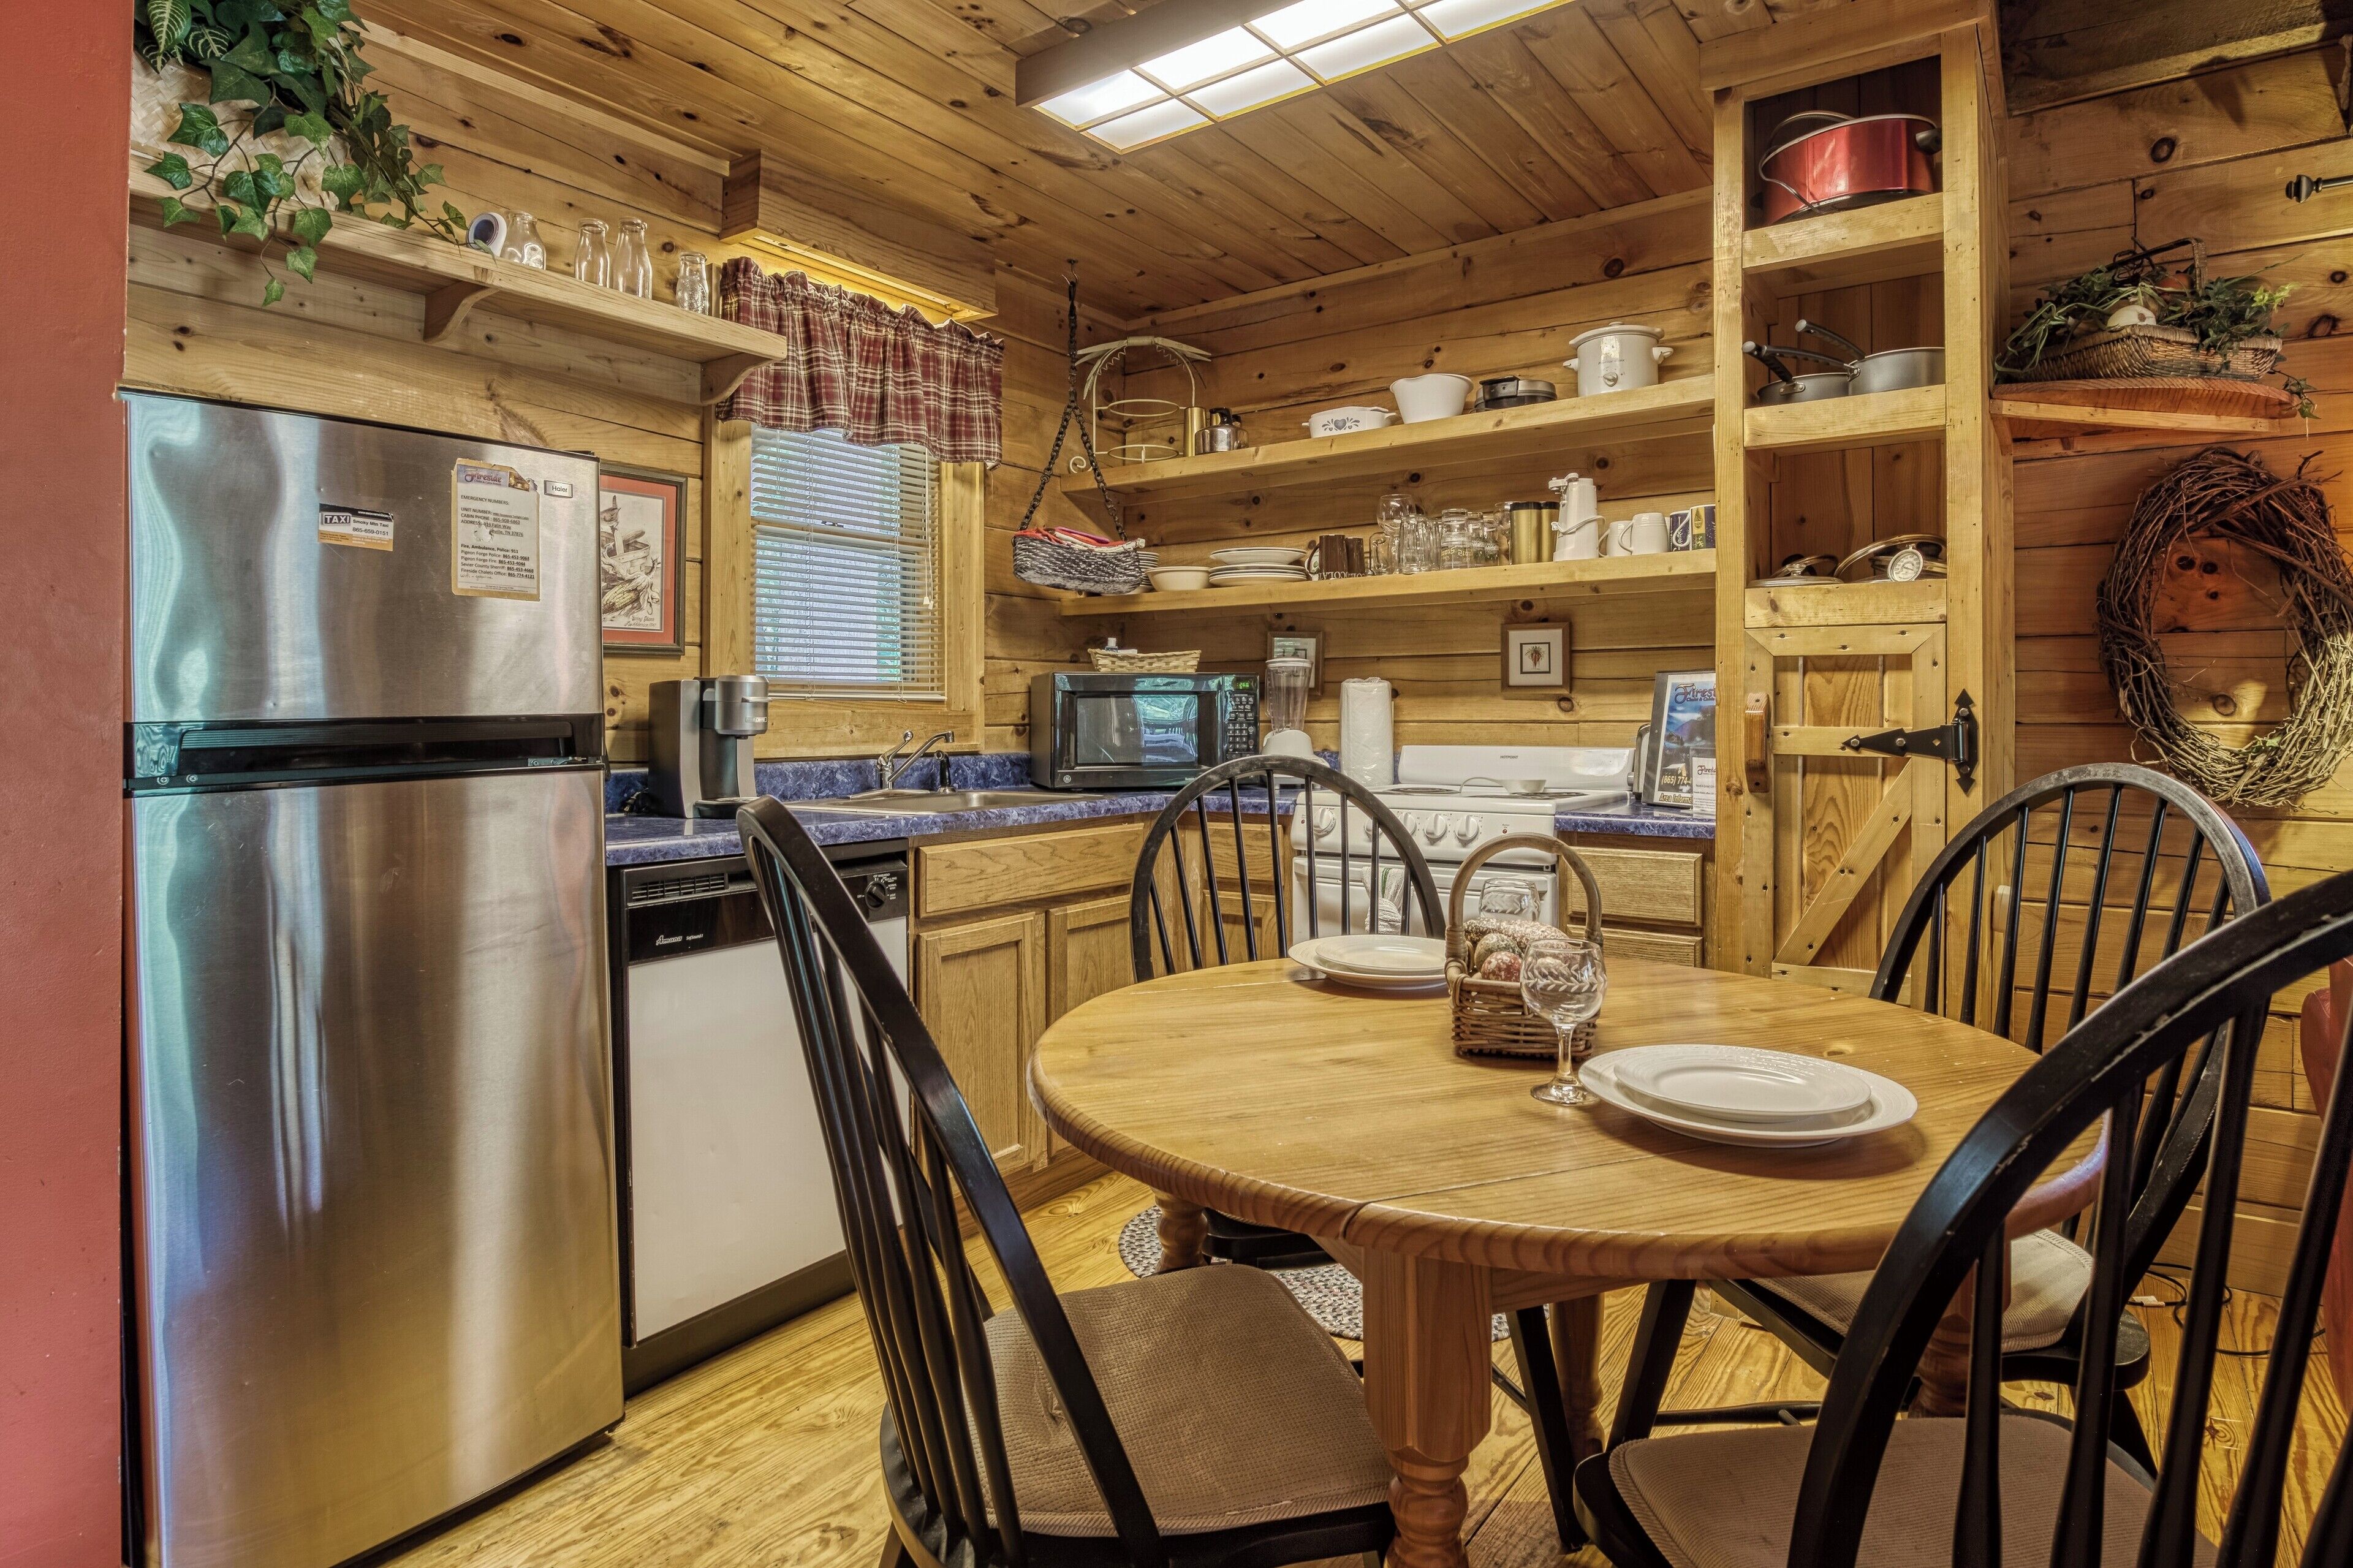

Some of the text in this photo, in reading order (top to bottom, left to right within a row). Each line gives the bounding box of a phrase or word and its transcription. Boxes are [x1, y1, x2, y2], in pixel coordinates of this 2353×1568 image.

[325, 515, 350, 524] TAXI
[352, 527, 389, 536] 865-659-0151
[1661, 775, 1677, 786] (865)
[1659, 792, 1672, 802] Area
[656, 934, 683, 945] Amana
